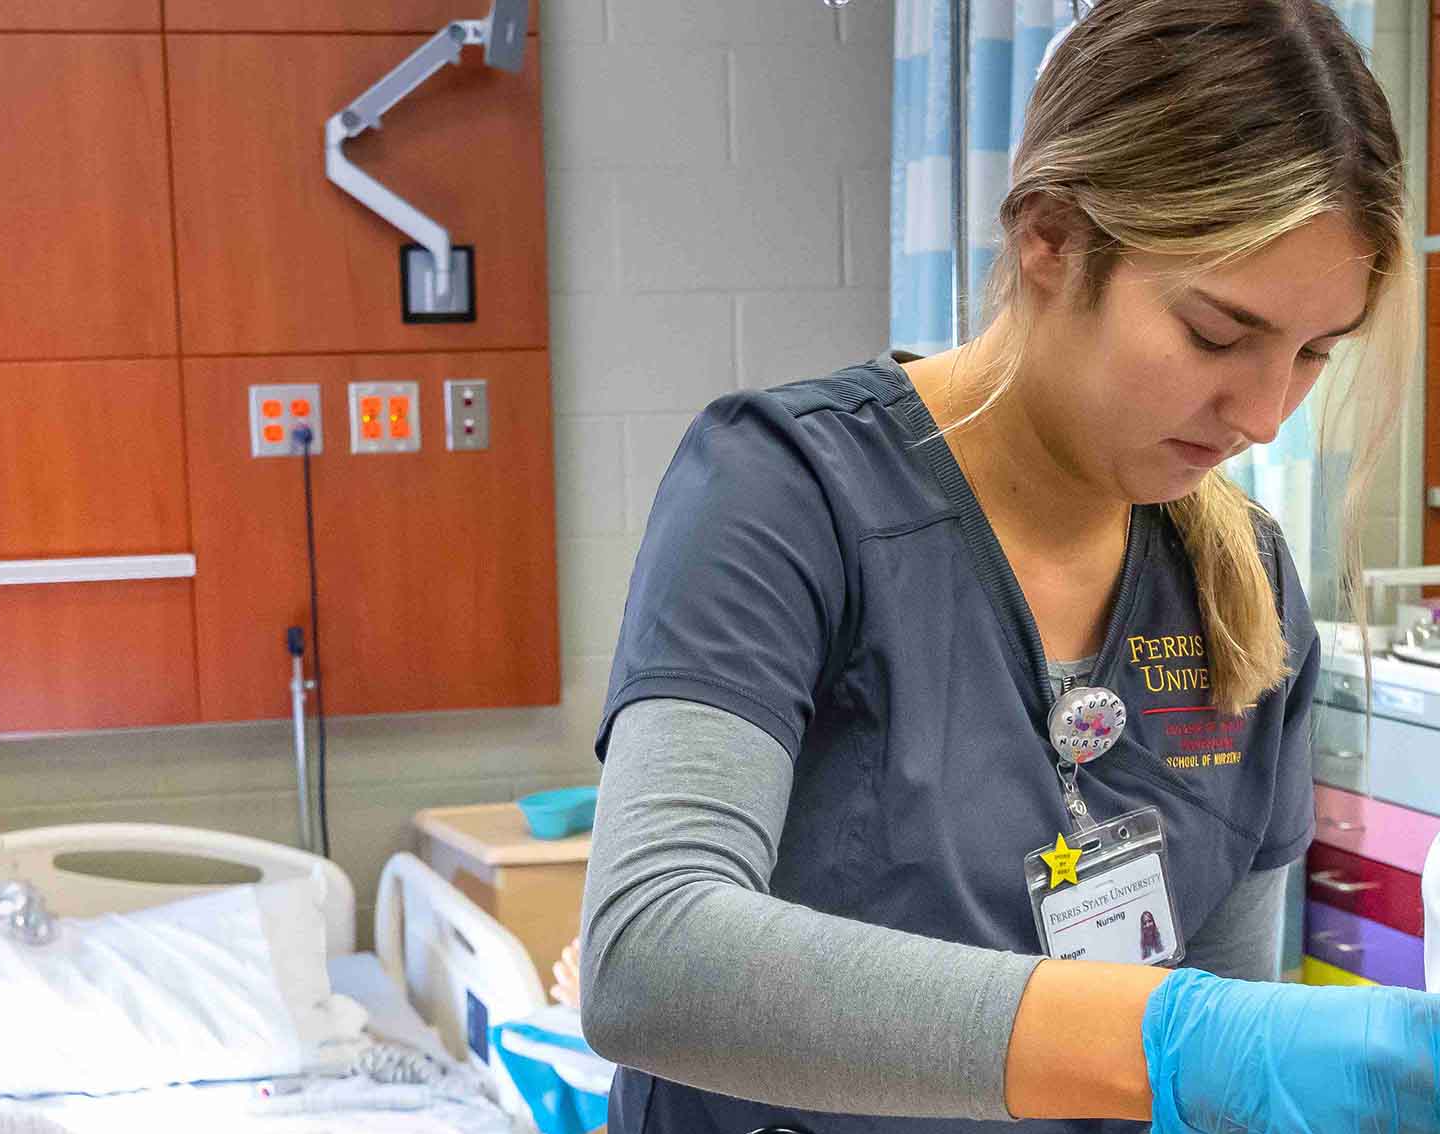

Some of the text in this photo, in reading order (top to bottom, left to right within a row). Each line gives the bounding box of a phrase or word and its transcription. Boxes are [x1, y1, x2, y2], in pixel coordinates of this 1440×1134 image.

[1127, 635, 1204, 663] FERRIS
[1140, 664, 1210, 692] UNIVE
[1066, 698, 1124, 727] STUDENT
[1059, 738, 1110, 749] NURSE
[1166, 755, 1200, 769] SCHOOL
[1202, 754, 1211, 767] OF
[1050, 873, 1161, 925] FERRIS STATE UNIVERSITY
[1096, 911, 1126, 929] Nursing
[1060, 946, 1087, 961] Megan
